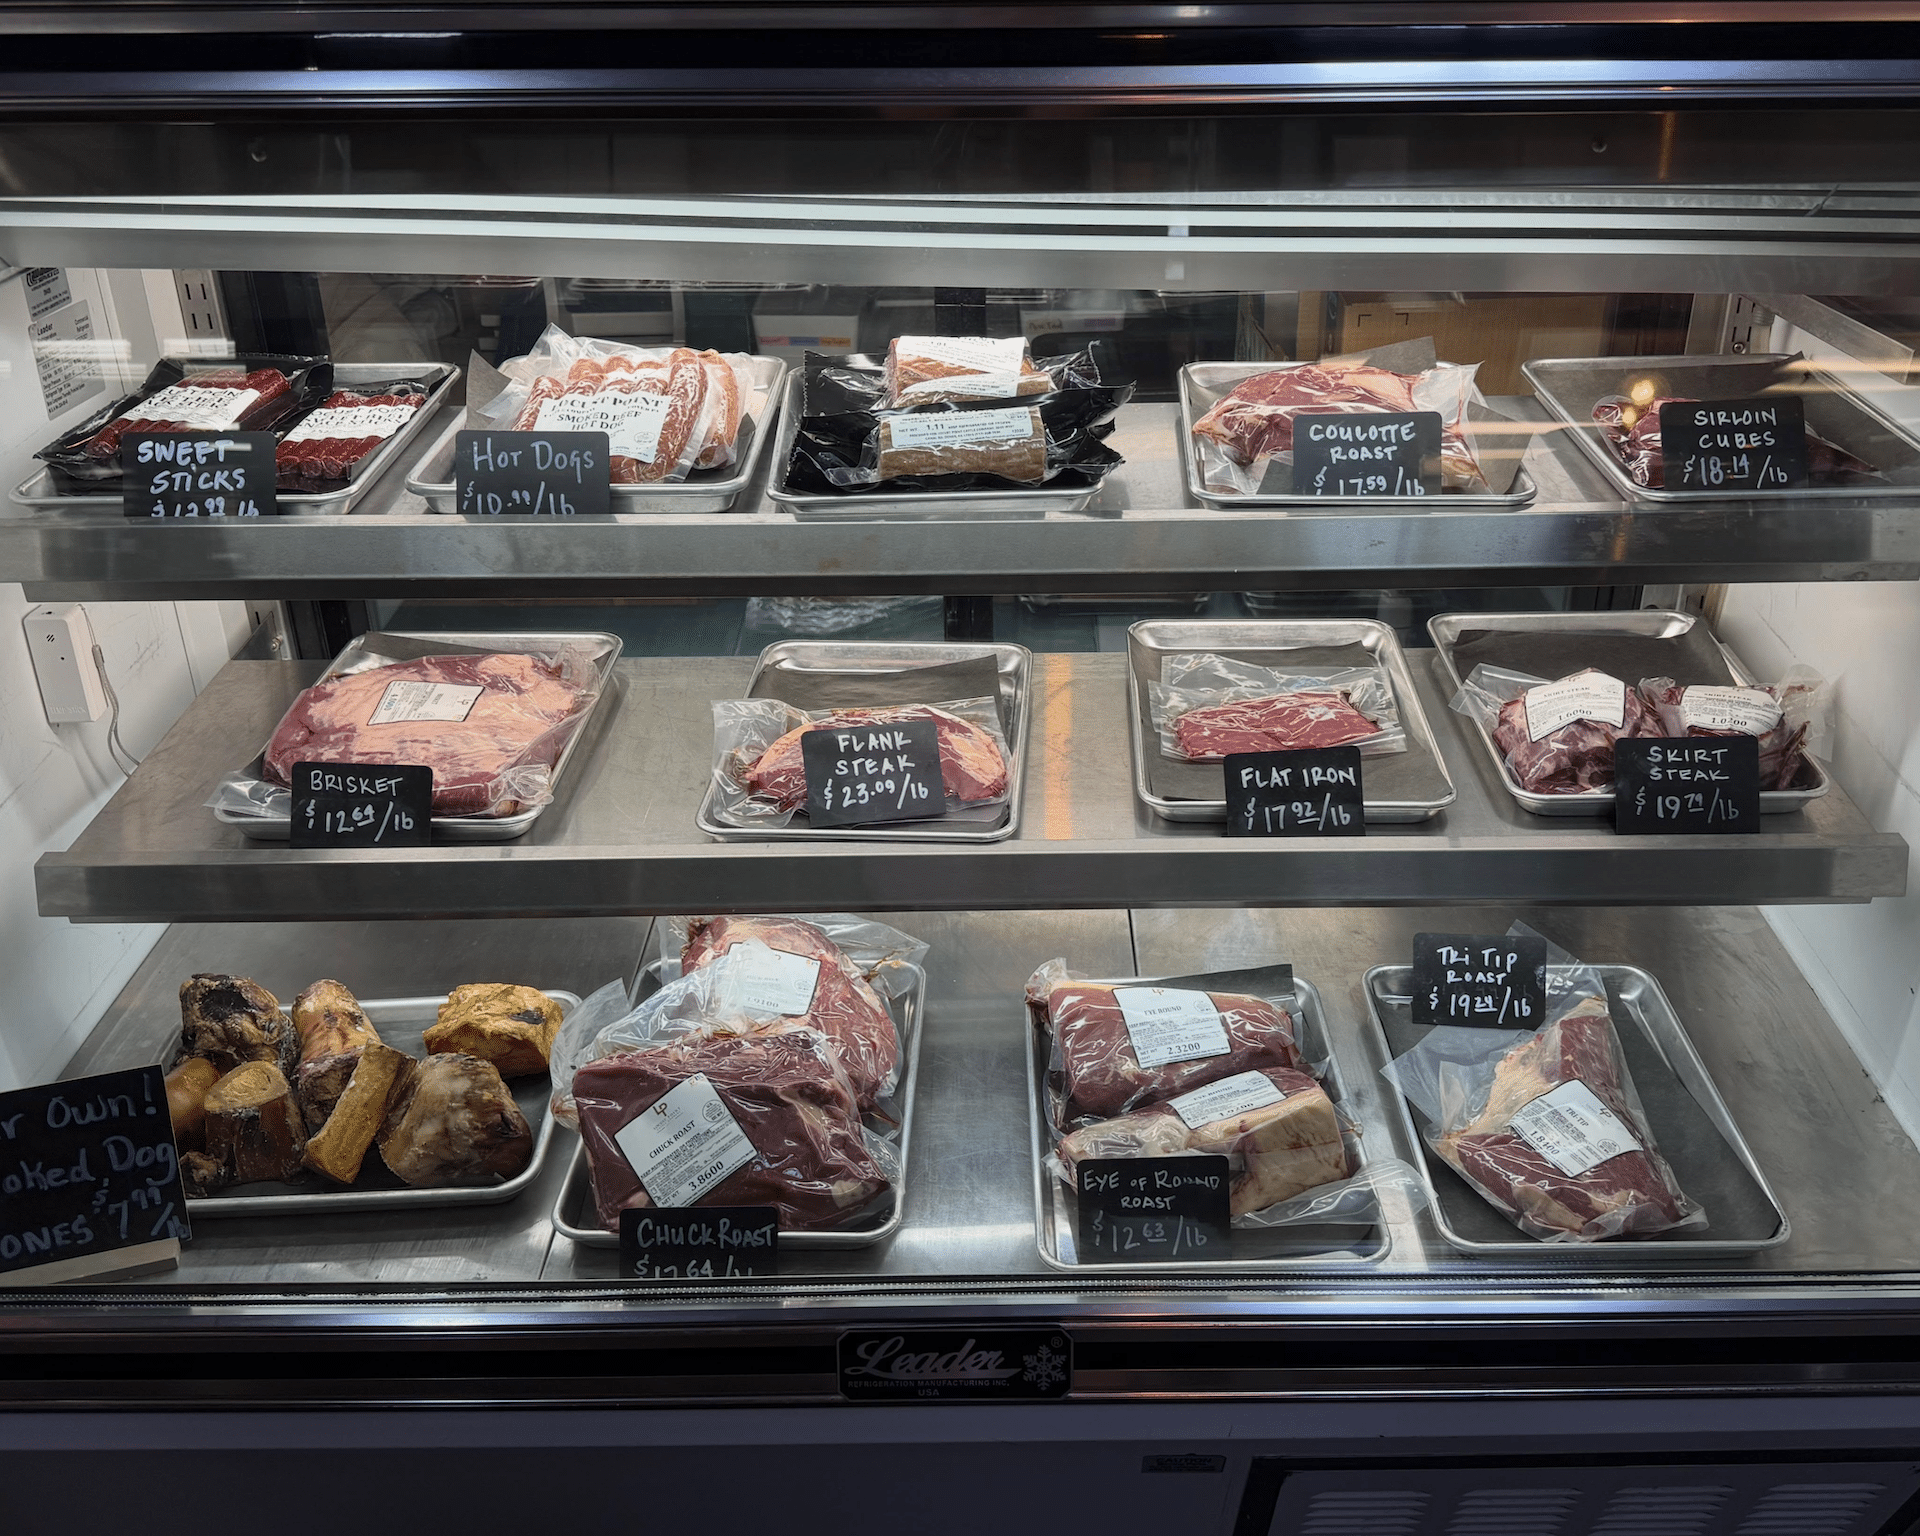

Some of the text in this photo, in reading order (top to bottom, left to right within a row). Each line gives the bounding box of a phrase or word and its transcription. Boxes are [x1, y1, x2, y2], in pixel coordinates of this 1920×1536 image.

[612, 396, 664, 407] POINT
[556, 411, 642, 424] SMOKED BEEF
[571, 420, 597, 431] HOT
[1694, 407, 1777, 426] SIRLOIN
[1309, 421, 1416, 443] COULOTTE
[1699, 430, 1776, 449] CUBES
[137, 440, 235, 467] SWEET
[1330, 446, 1398, 464] ROAST
[150, 468, 246, 495] STICKS
[837, 731, 912, 753] FLANK
[1646, 745, 1729, 765] SKIRT
[835, 754, 916, 777] STEAK
[1649, 766, 1730, 782] STEAK
[310, 769, 404, 797] BRISKET
[1240, 766, 1357, 789] FLAT IRON
[1447, 970, 1507, 985] ROAST
[1166, 1042, 1201, 1056] 2.3200
[47, 1072, 158, 1129] Own!
[1565, 1107, 1589, 1127] TRI-TIP
[648, 1137, 675, 1159] CHUCK
[672, 1120, 697, 1142] ROAST
[103, 1135, 178, 1186] Dog
[687, 1160, 725, 1192] 3.8600
[1083, 1169, 1120, 1192] EYE
[1121, 1195, 1177, 1211] ROAST
[844, 1335, 1023, 1381] Leader
[848, 1379, 1010, 1389] REFRIGERATION MANUFACTURING INC.
[918, 1388, 940, 1397] USA
